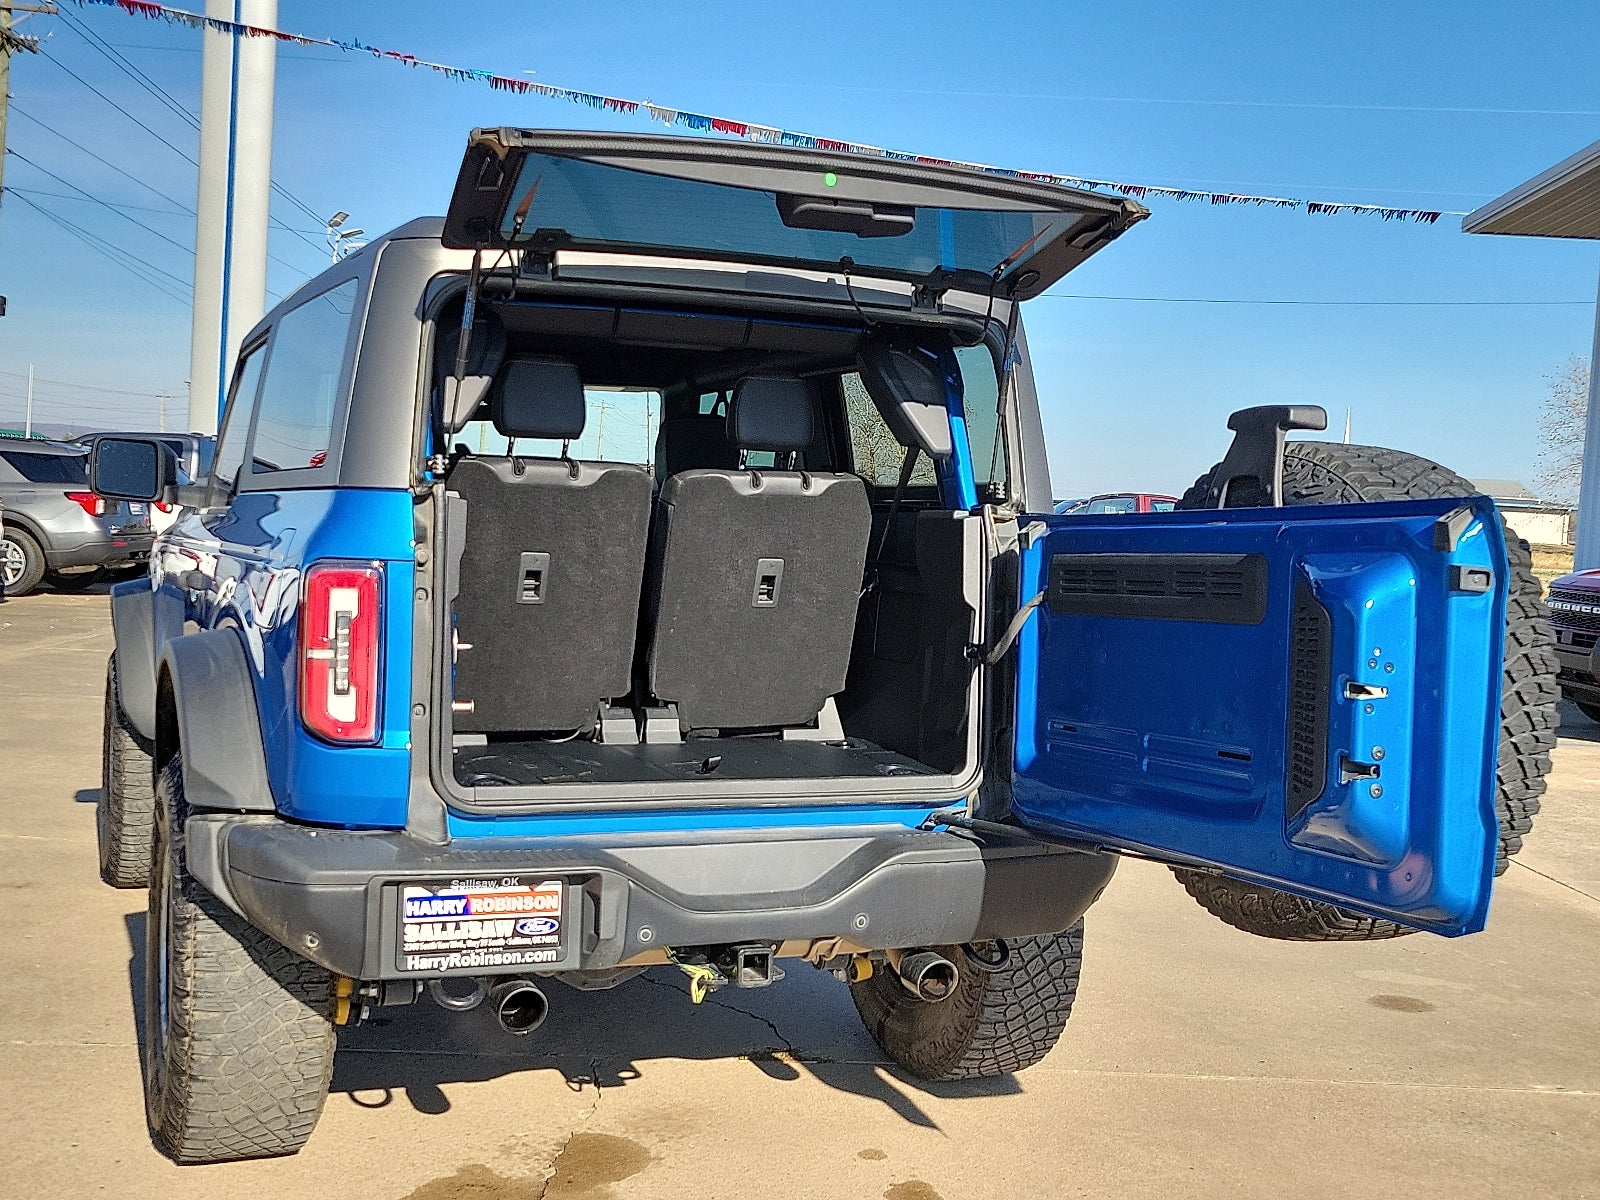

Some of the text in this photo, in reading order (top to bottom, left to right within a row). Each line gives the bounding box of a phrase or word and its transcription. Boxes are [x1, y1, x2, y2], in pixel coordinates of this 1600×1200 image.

[1547, 601, 1600, 614] BRONCO
[451, 877, 519, 889] Sallisaw, OK
[407, 895, 559, 917] HARRY ROBINSON
[404, 919, 515, 942] SALLISAW
[406, 950, 557, 970] HarryRobinson.com
